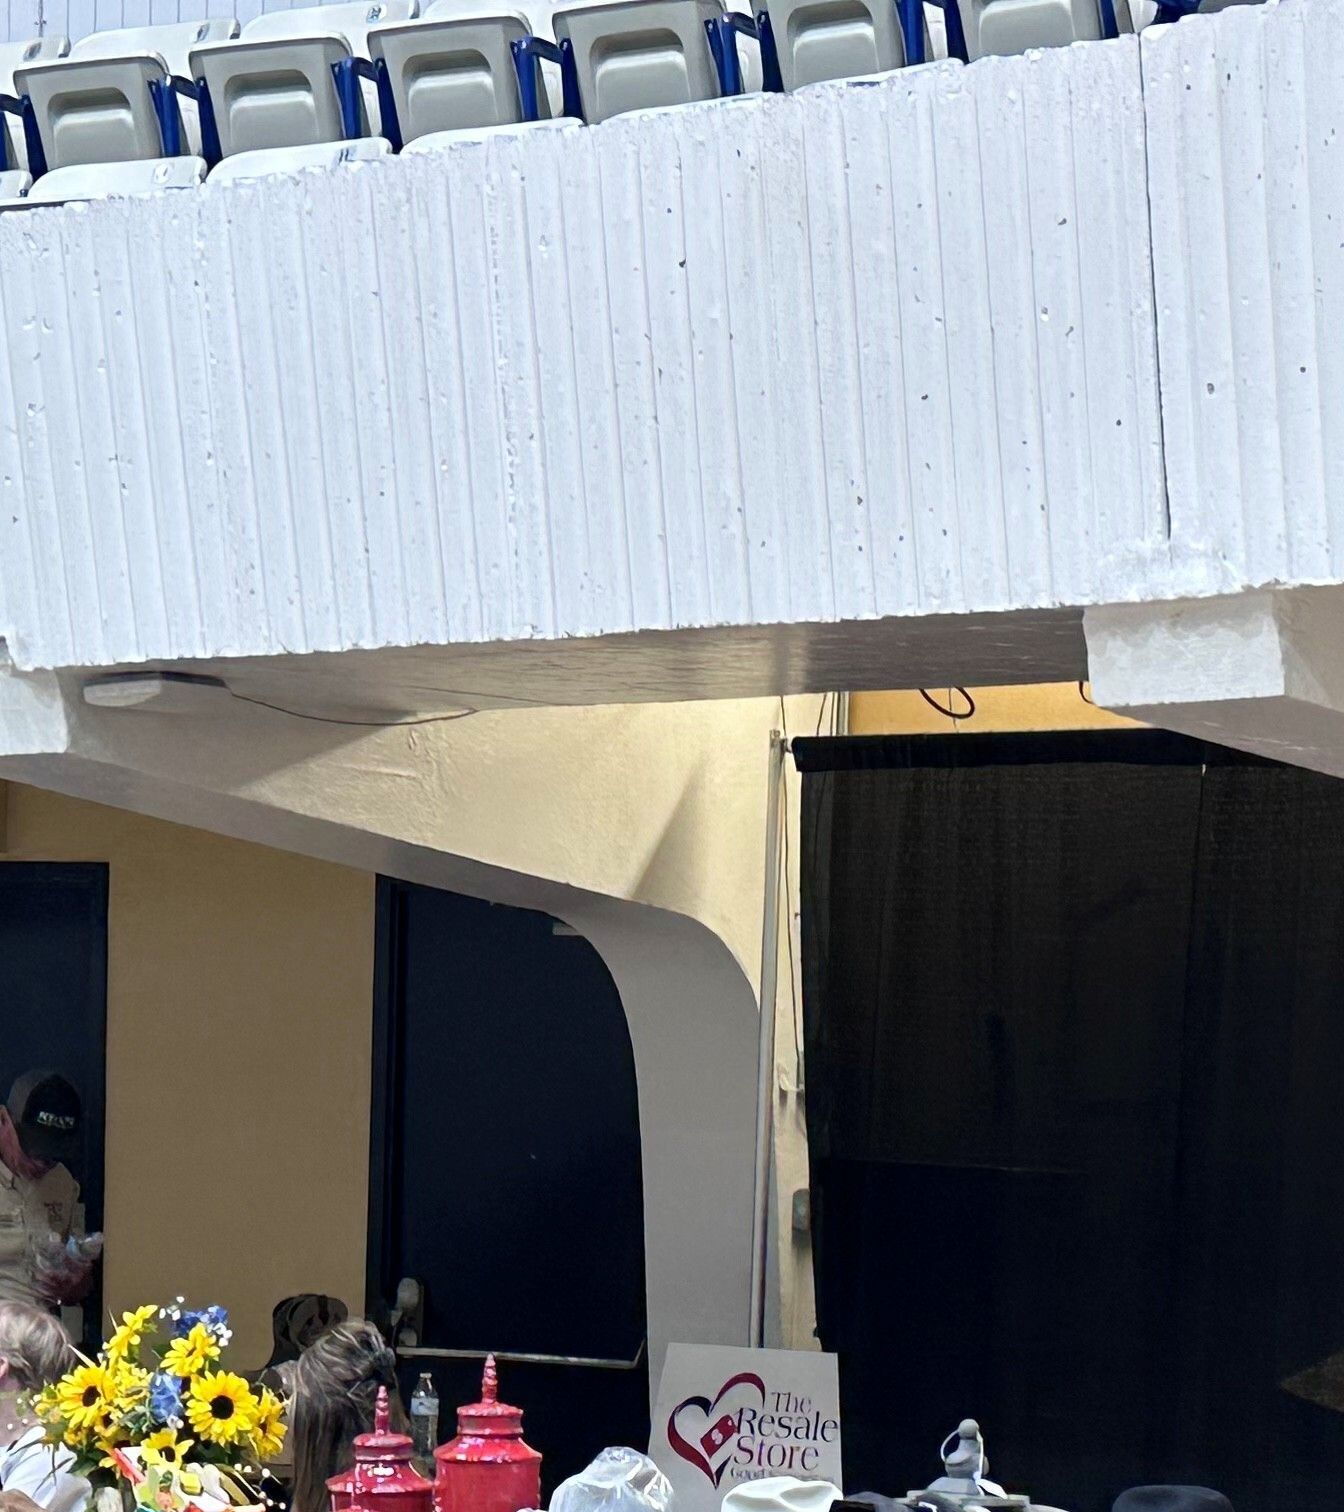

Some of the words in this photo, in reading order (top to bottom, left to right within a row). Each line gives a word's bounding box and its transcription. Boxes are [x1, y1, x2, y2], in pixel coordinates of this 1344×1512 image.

[771, 1391, 812, 1414] The
[734, 1407, 839, 1443] Resale
[732, 1436, 820, 1471] Store
